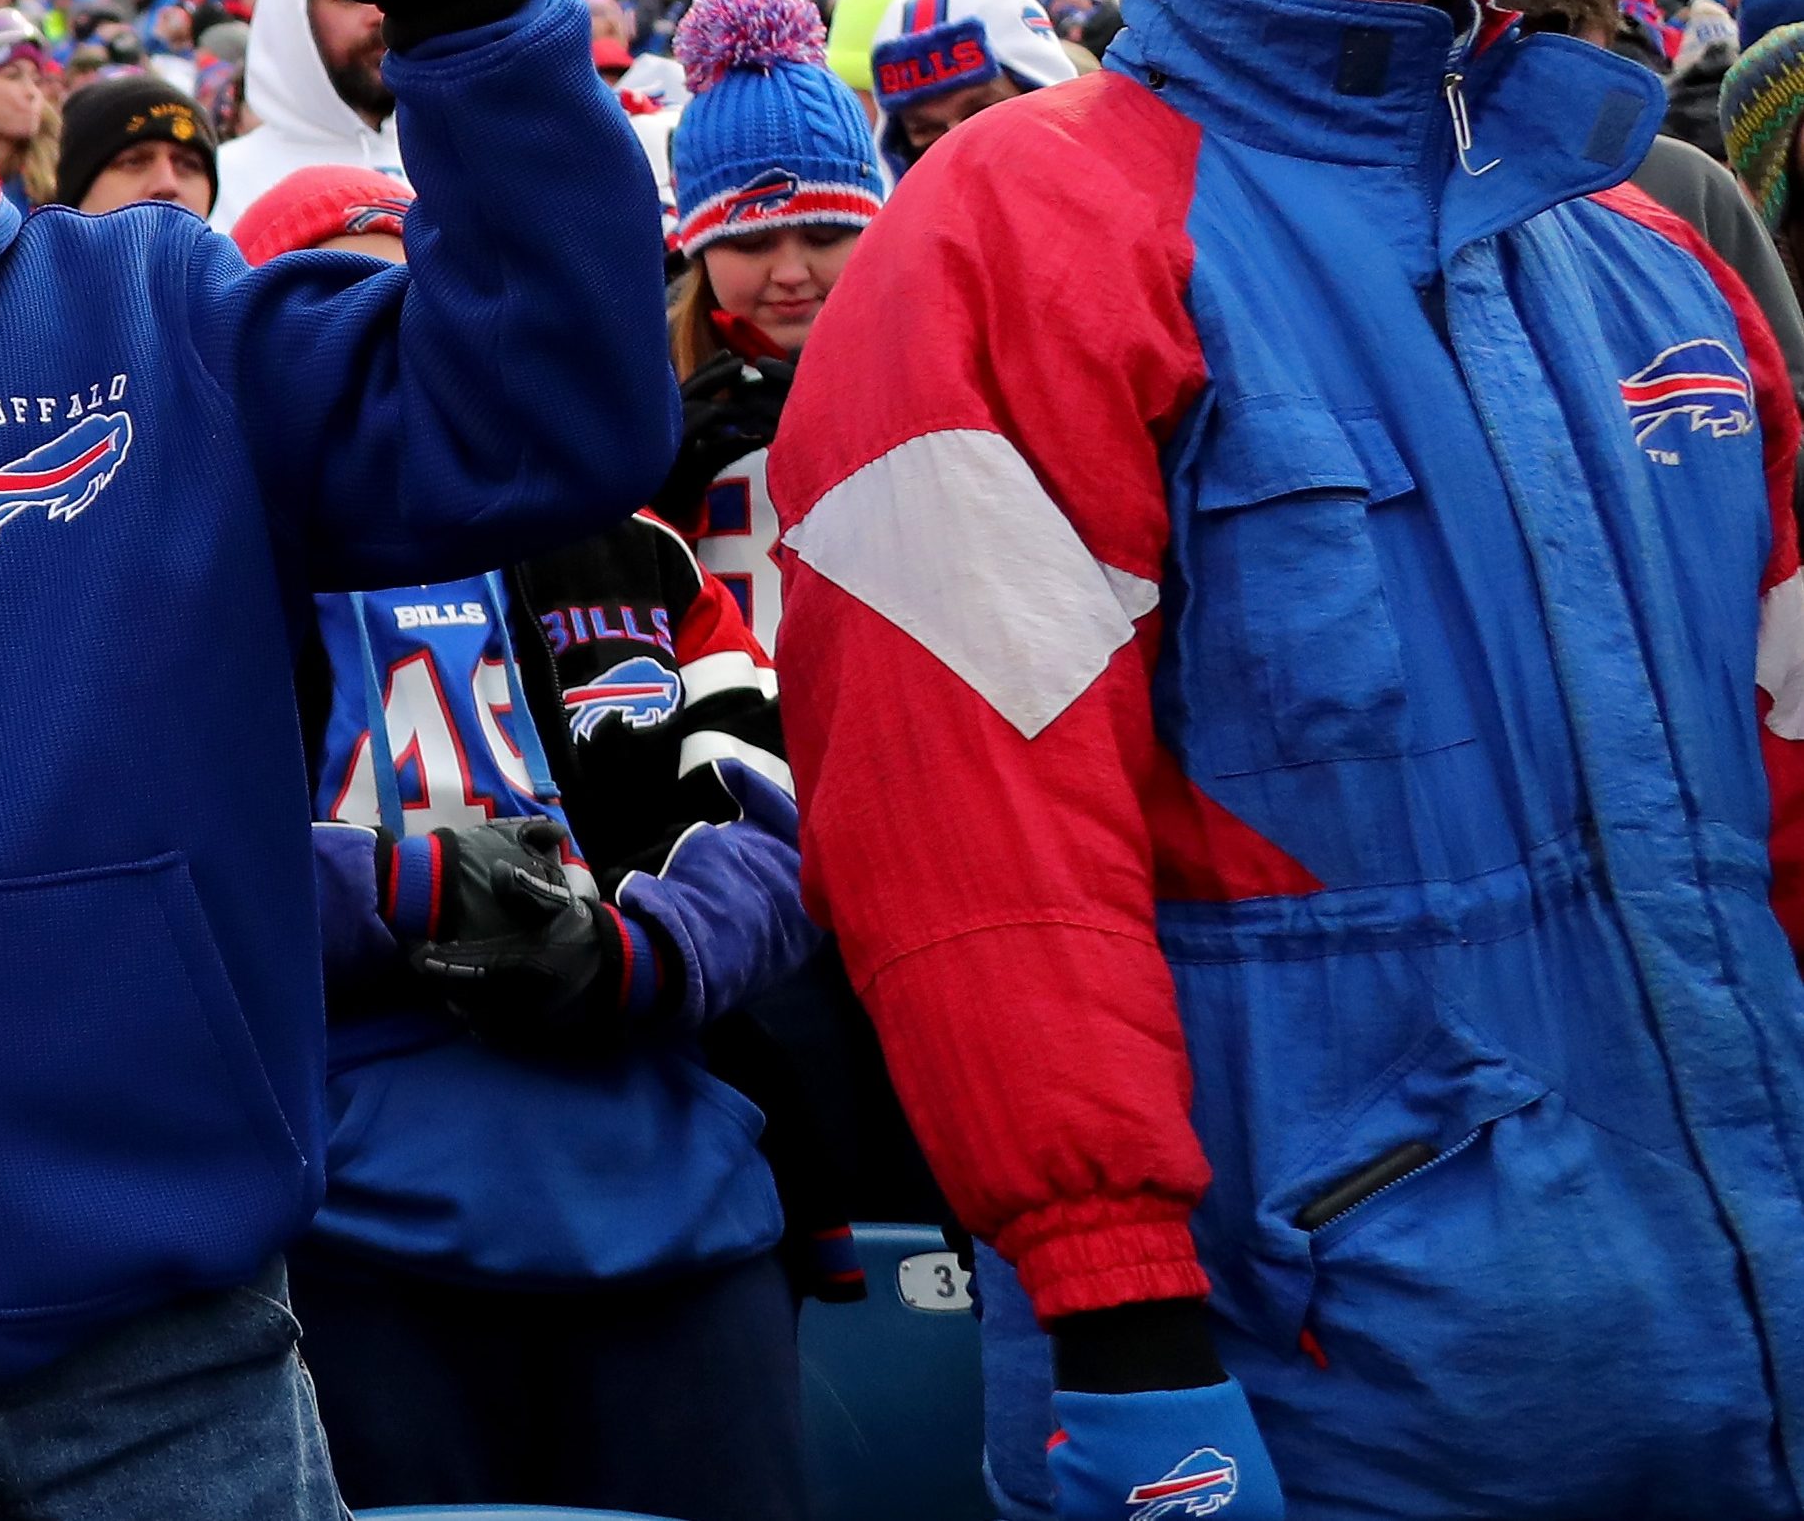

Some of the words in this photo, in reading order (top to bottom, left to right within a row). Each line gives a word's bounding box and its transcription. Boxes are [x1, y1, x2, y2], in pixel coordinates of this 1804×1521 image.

[879, 38, 986, 95] BILLS
[1646, 448, 1680, 466] TM
[393, 600, 487, 630] BILLS
[541, 604, 673, 658] BILLS
